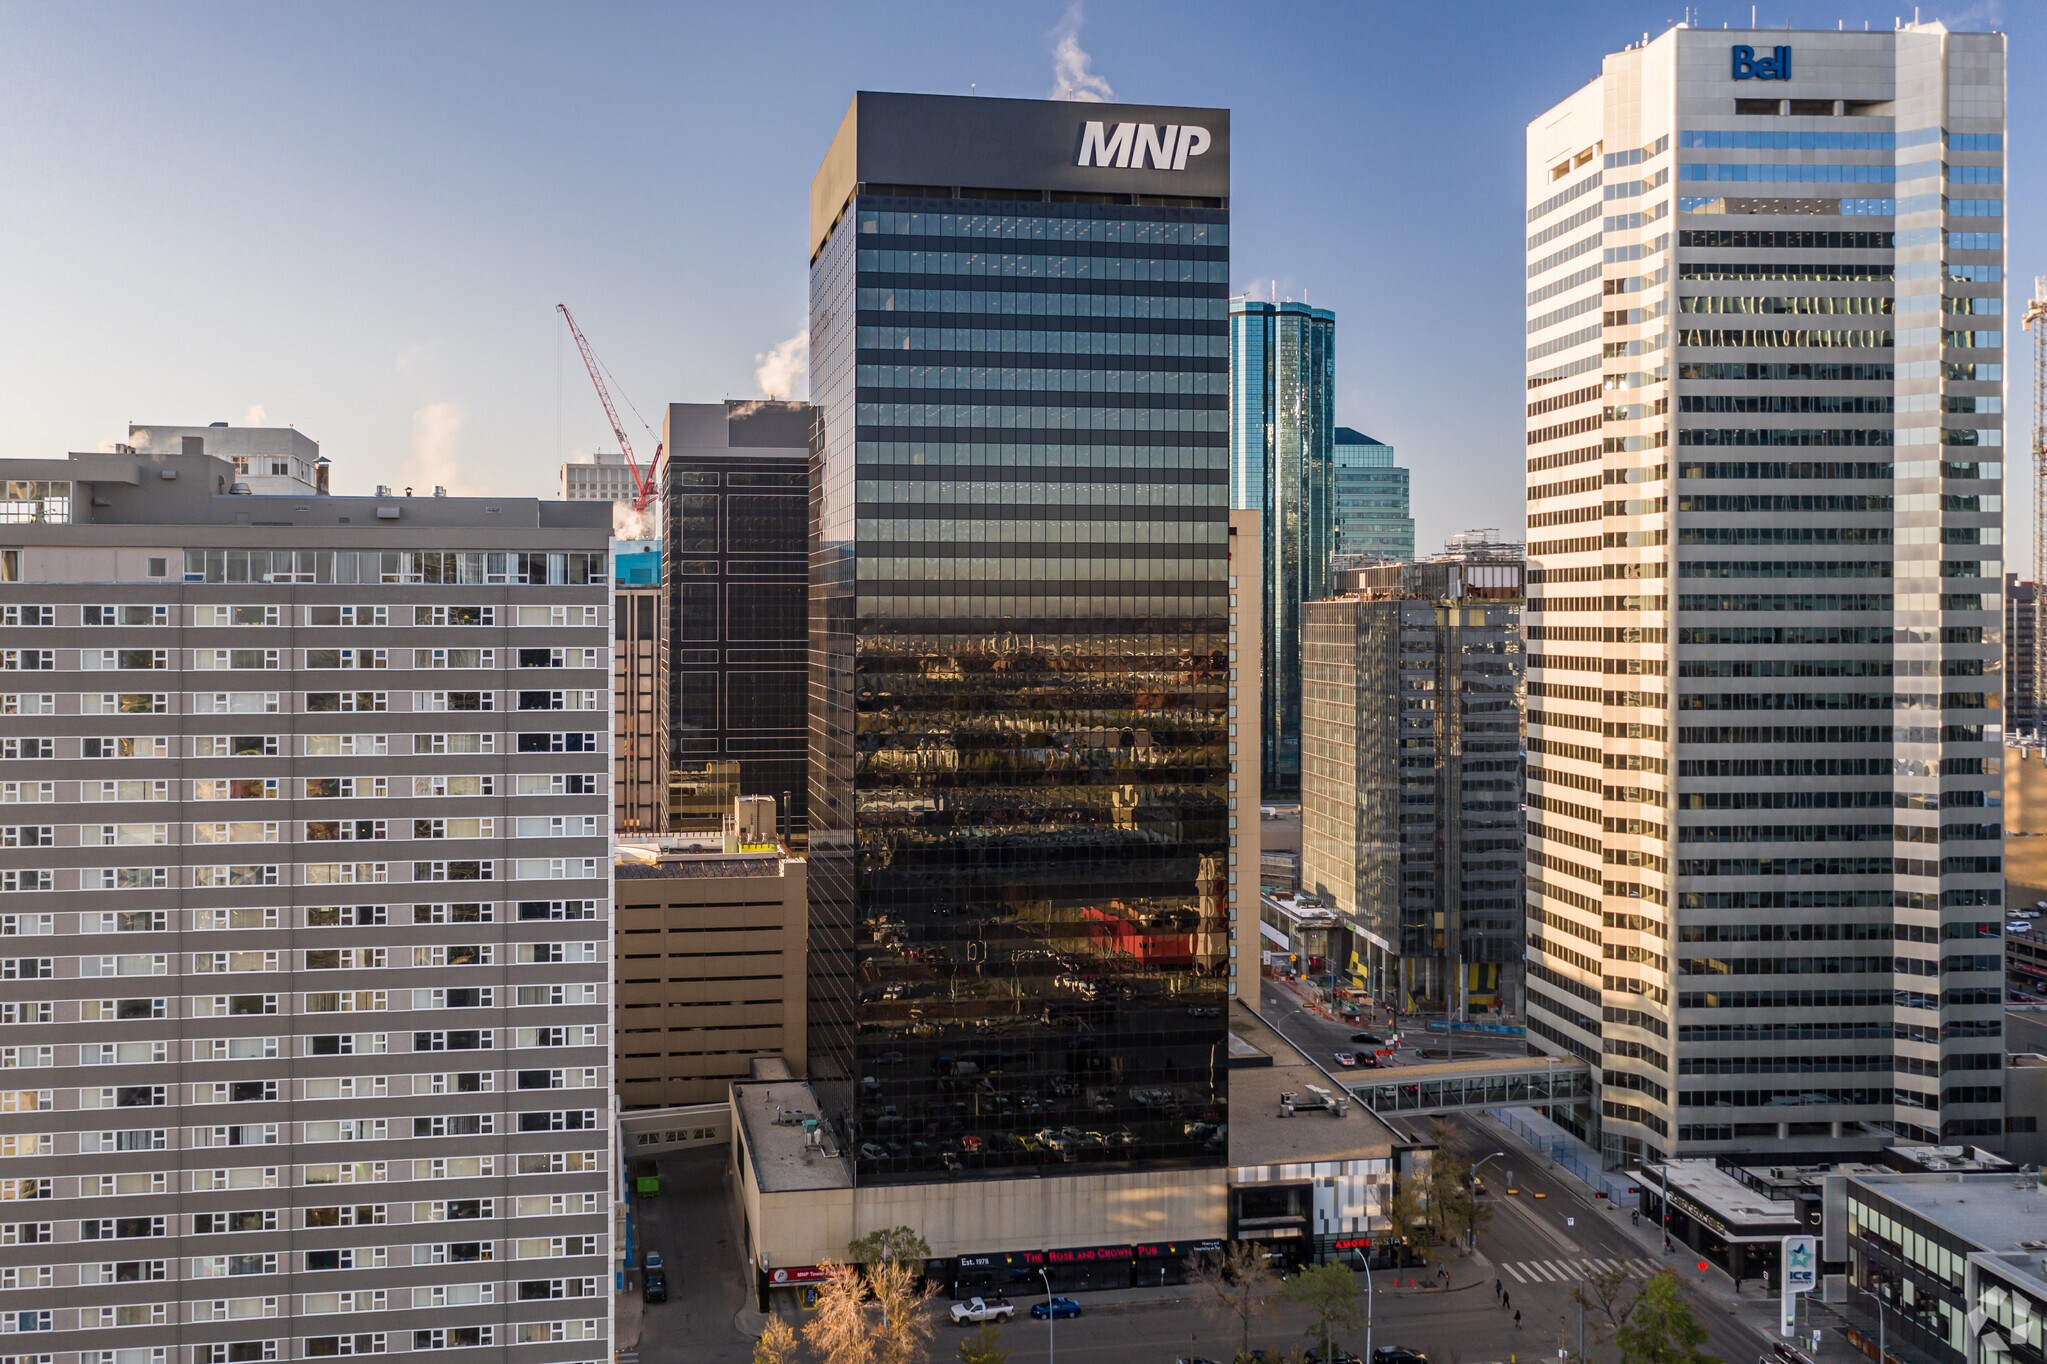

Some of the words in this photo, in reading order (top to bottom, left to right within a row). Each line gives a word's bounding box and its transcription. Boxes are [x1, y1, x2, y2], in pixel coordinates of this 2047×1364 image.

[1731, 44, 1792, 80] Bell
[1077, 121, 1212, 171] MNP
[961, 1257, 975, 1266] Est.
[976, 1257, 990, 1266] 1978
[1049, 1251, 1074, 1262] ROSE
[1077, 1251, 1095, 1260] AND
[1097, 1247, 1132, 1258] CROWN
[1138, 1245, 1158, 1256] PUB
[1789, 1271, 1812, 1280] ICE
